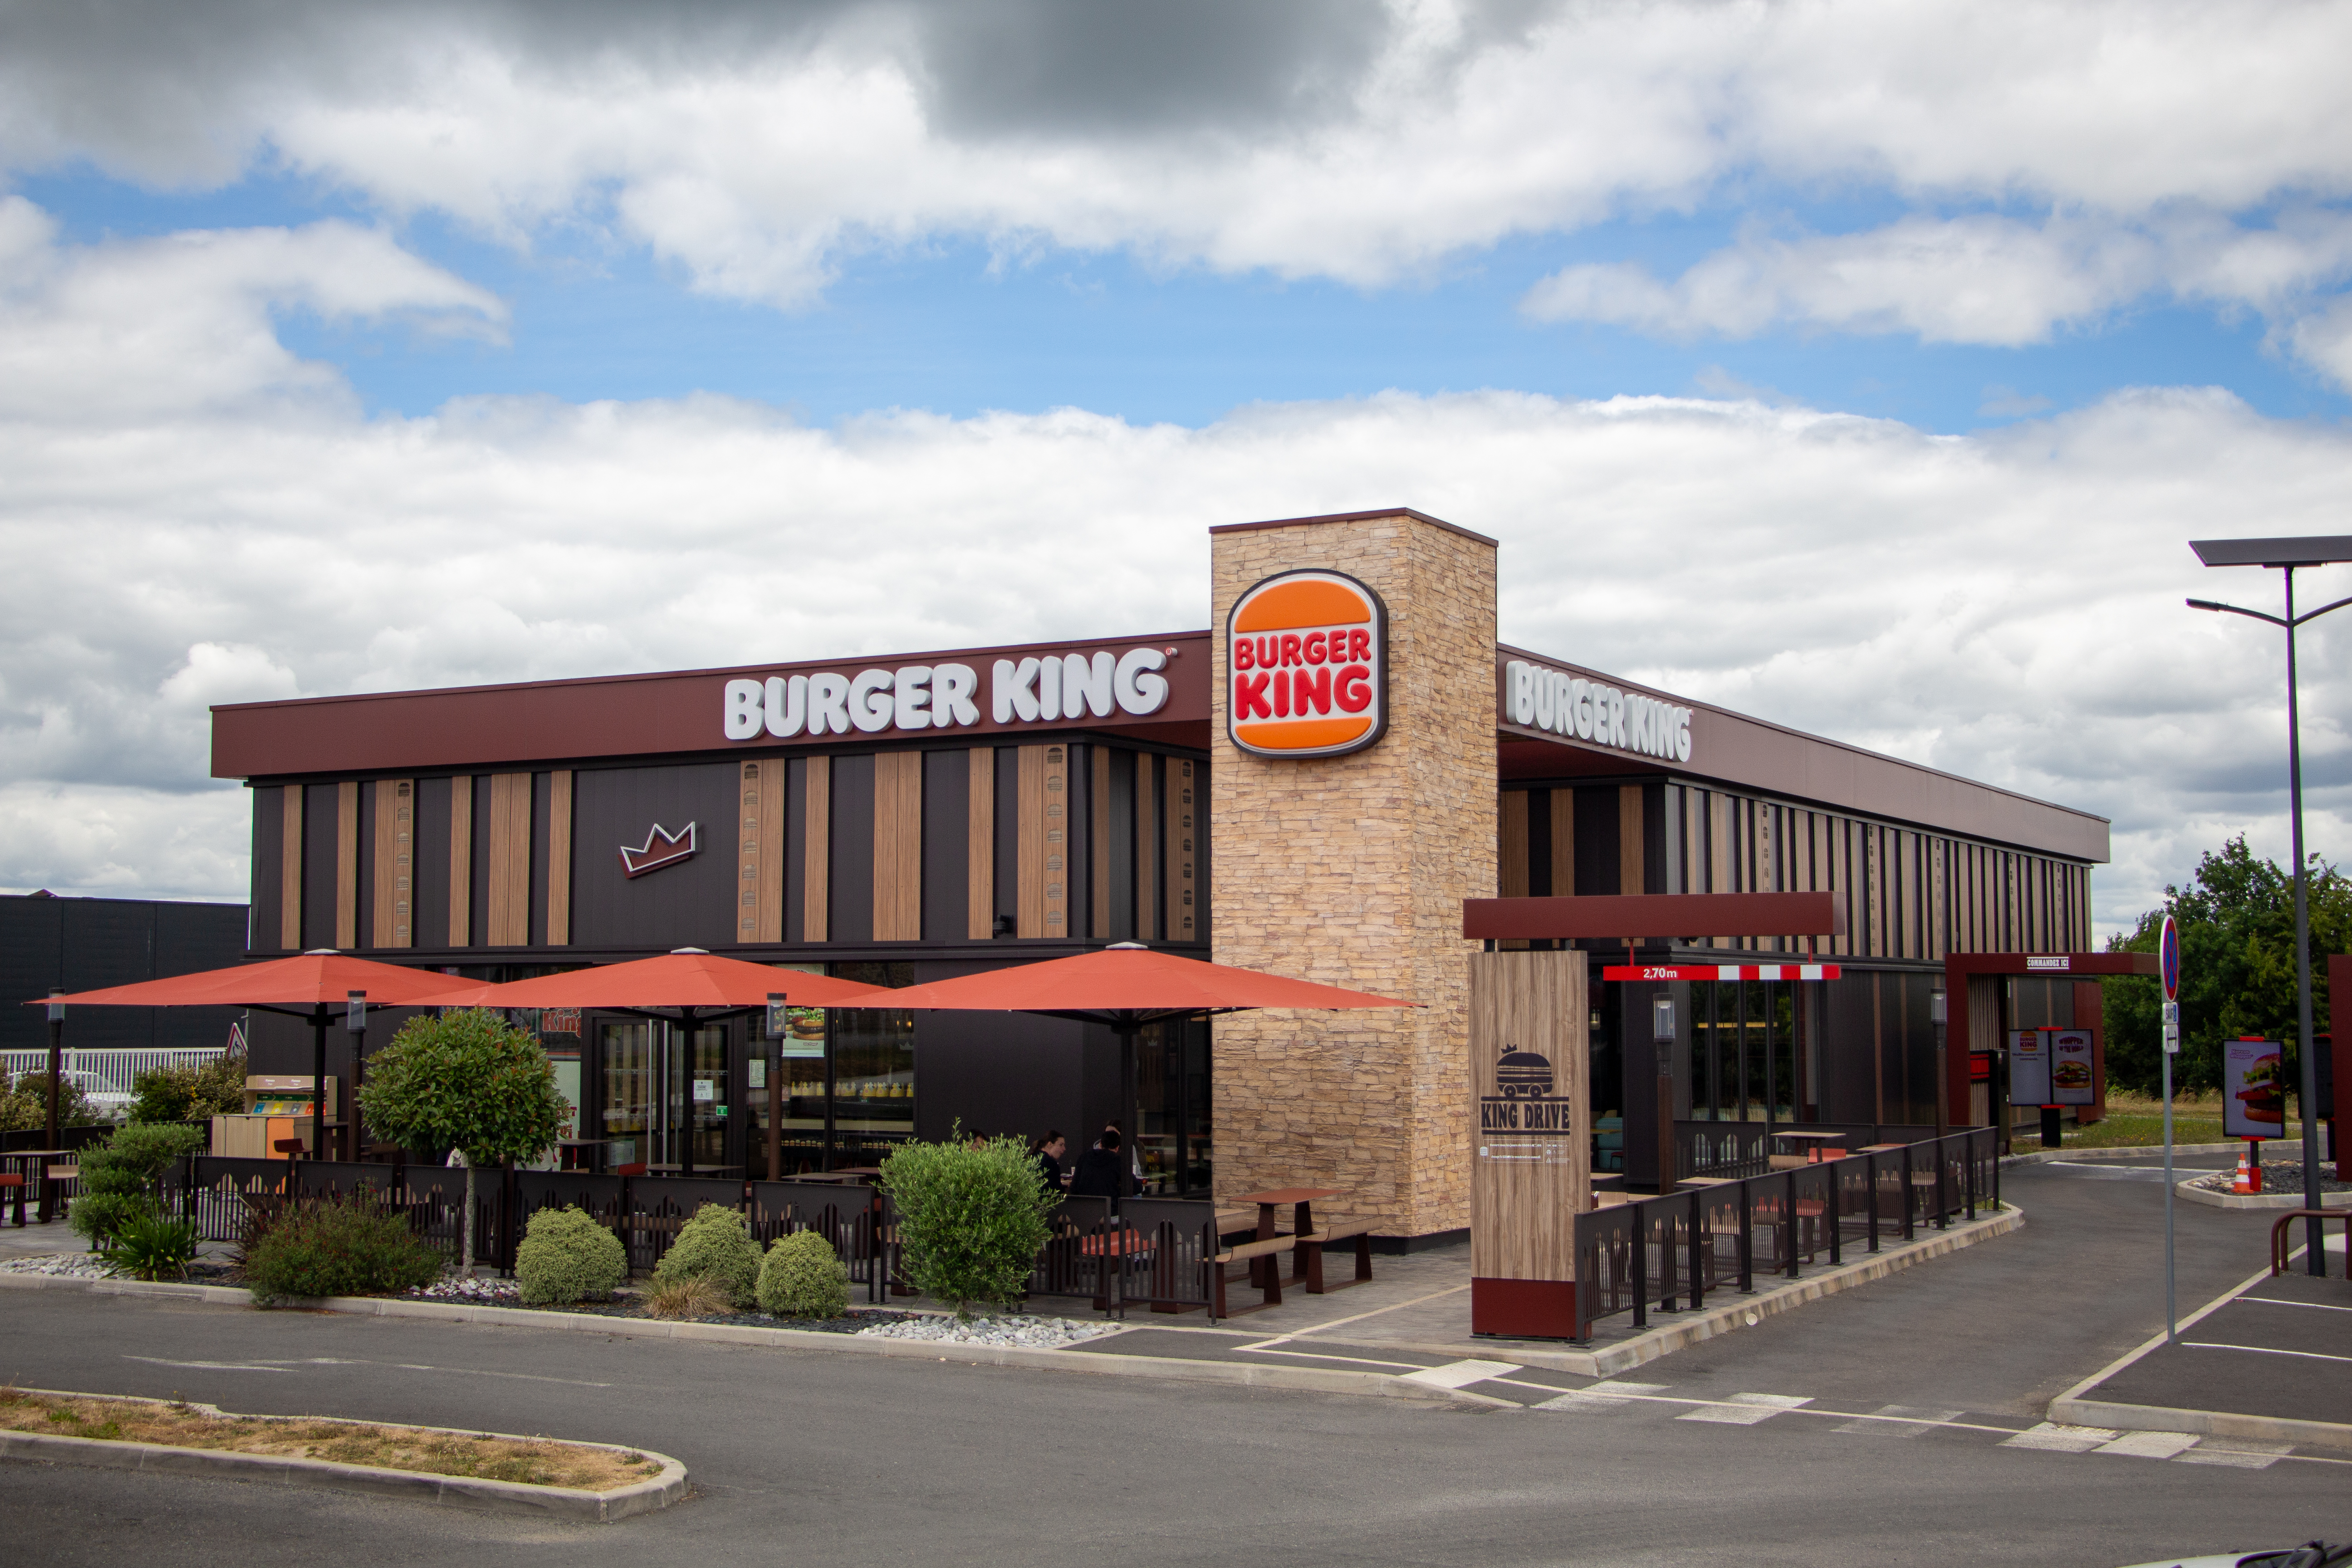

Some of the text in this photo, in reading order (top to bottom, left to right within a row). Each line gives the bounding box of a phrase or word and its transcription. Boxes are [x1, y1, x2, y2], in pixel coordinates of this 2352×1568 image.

[1235, 628, 1371, 671] BURGER
[725, 647, 1169, 740] BURGER KING
[1235, 664, 1372, 720] KING
[1506, 660, 1691, 763] BURGER KING
[2027, 959, 2059, 967] COMMANDEZ
[1481, 1103, 1569, 1129] KING DRIVE
